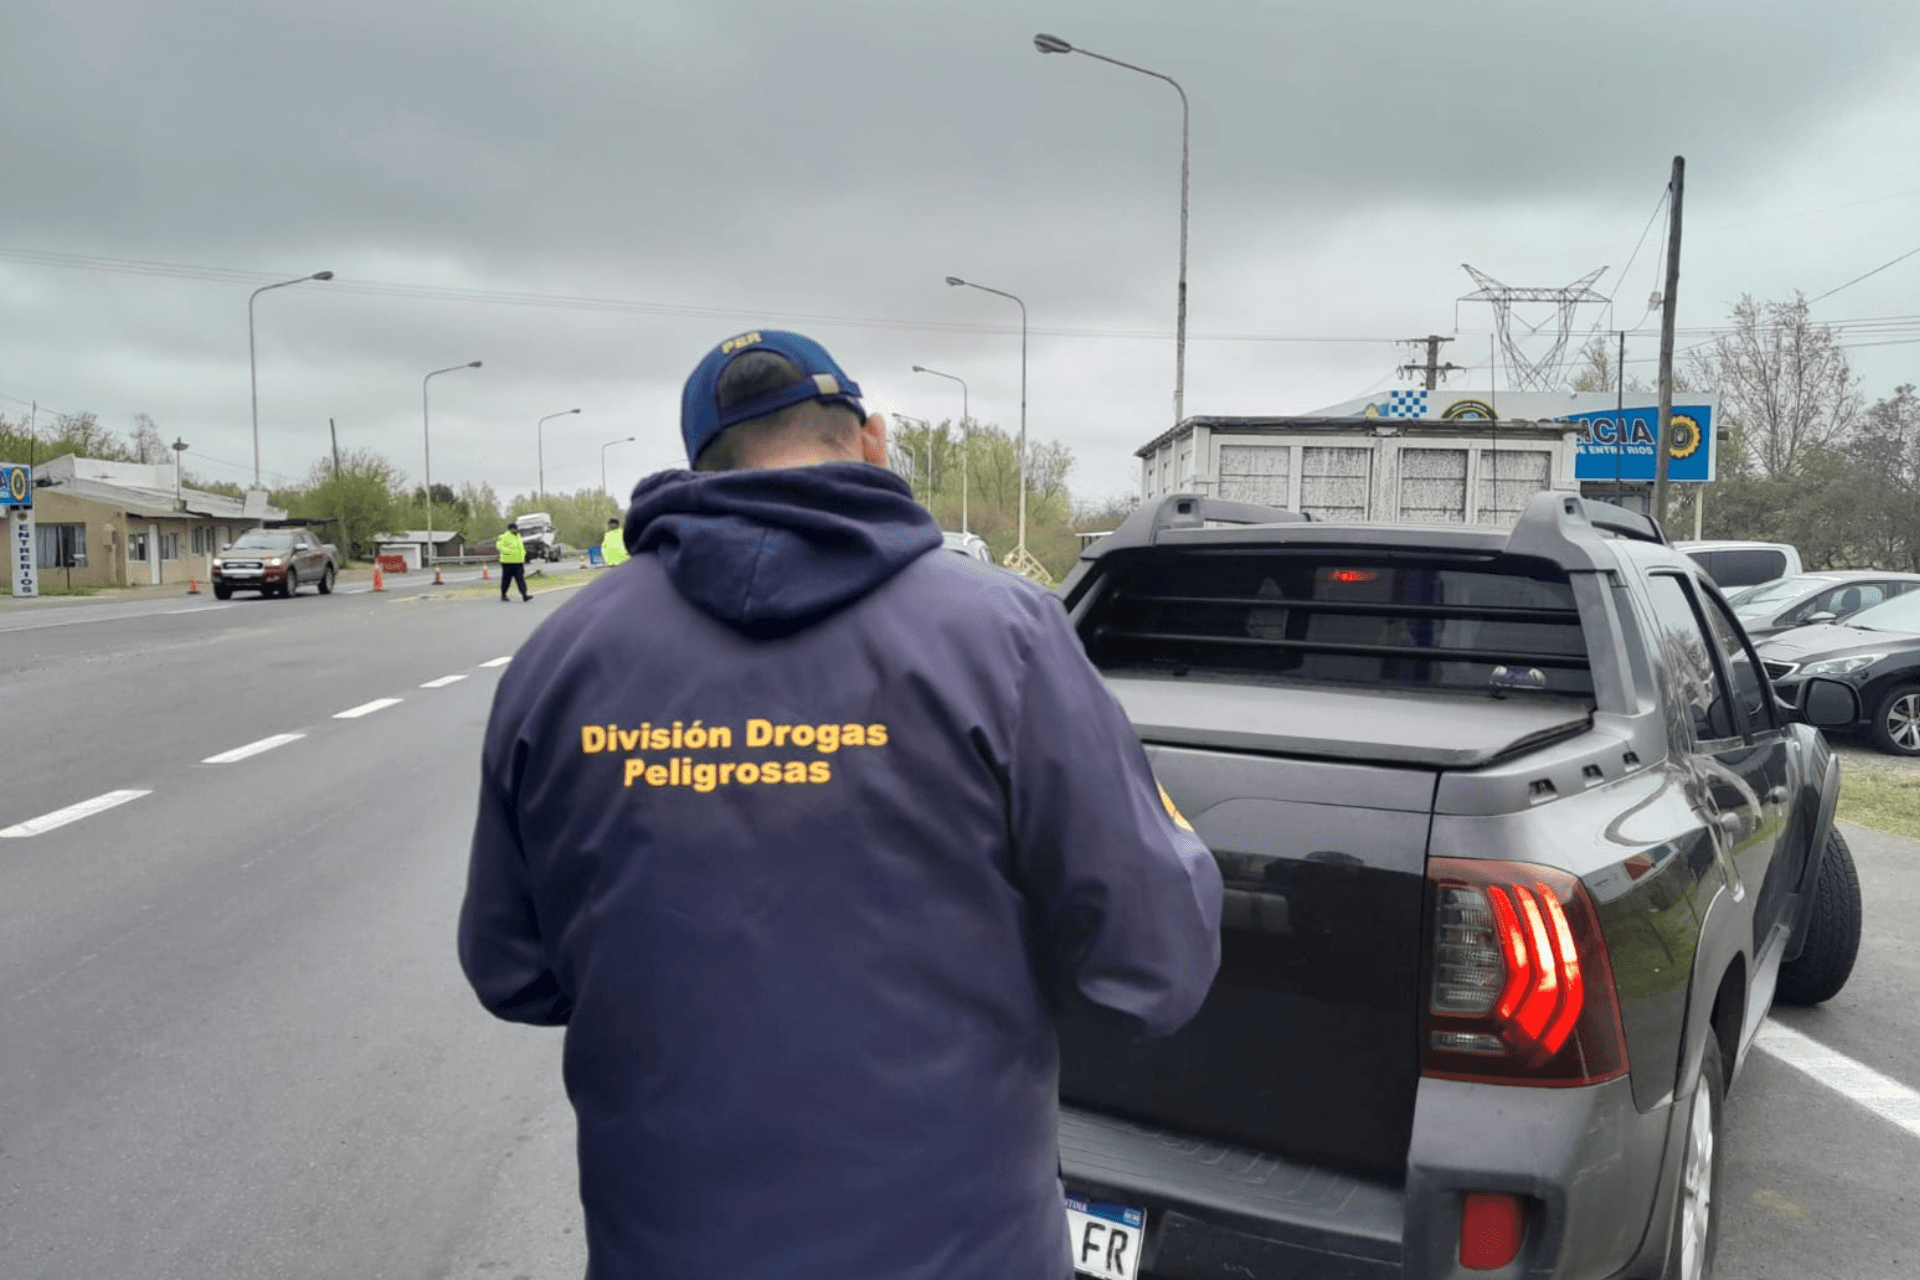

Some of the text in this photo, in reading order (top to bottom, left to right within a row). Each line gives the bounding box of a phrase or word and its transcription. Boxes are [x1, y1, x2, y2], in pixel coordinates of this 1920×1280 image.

[722, 332, 762, 354] PER
[1626, 445, 1654, 455] RIOS
[581, 718, 888, 754] División Drogas
[624, 757, 831, 792] Peligrosas
[1082, 1221, 1129, 1276] FR
